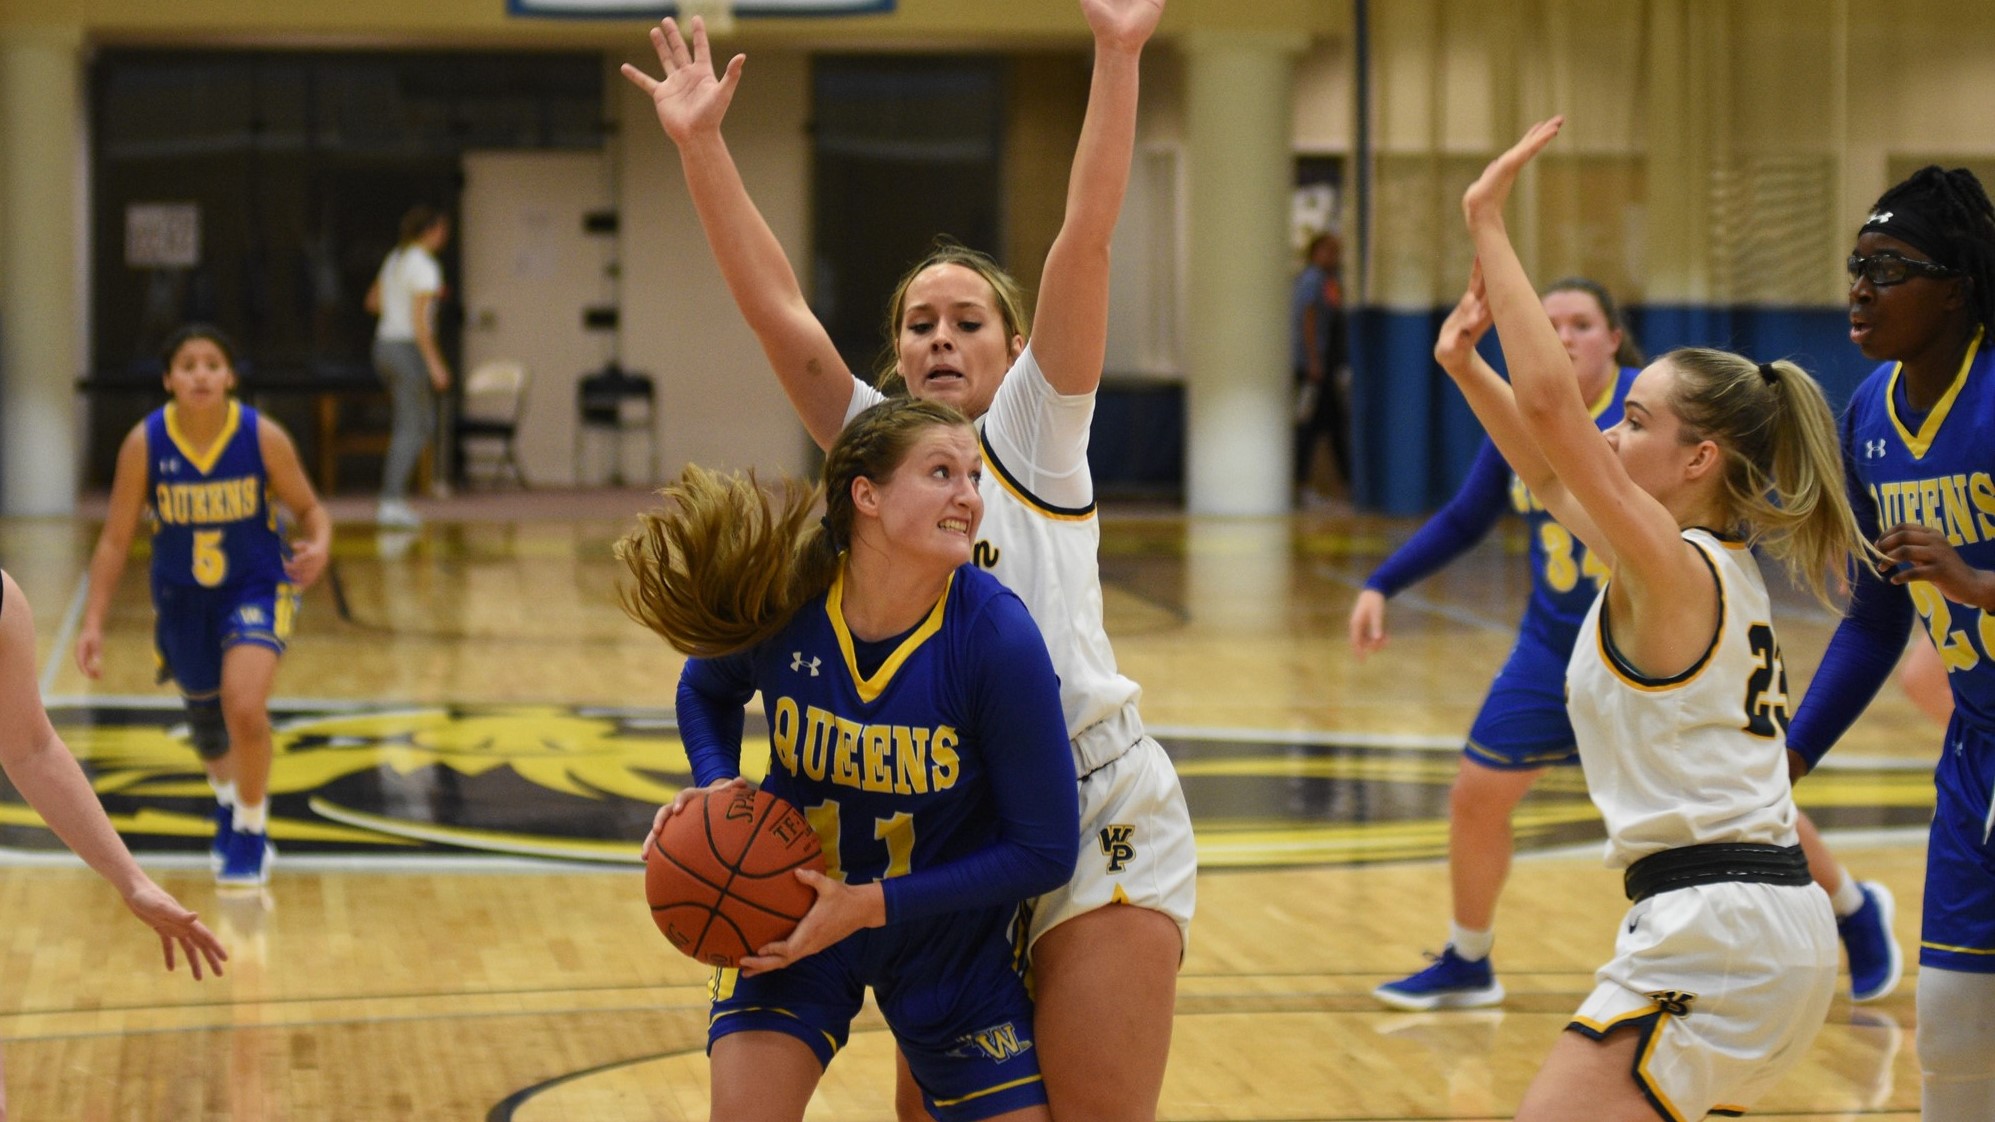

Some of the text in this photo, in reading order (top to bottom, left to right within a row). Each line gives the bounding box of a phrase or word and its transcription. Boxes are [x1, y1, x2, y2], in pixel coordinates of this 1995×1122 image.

[156, 476, 259, 525] QUEENS
[1869, 472, 1995, 547] UEENS
[192, 530, 227, 588] 5
[774, 696, 960, 795] QUEENS
[804, 798, 915, 885] 11
[975, 1022, 1020, 1064] W
